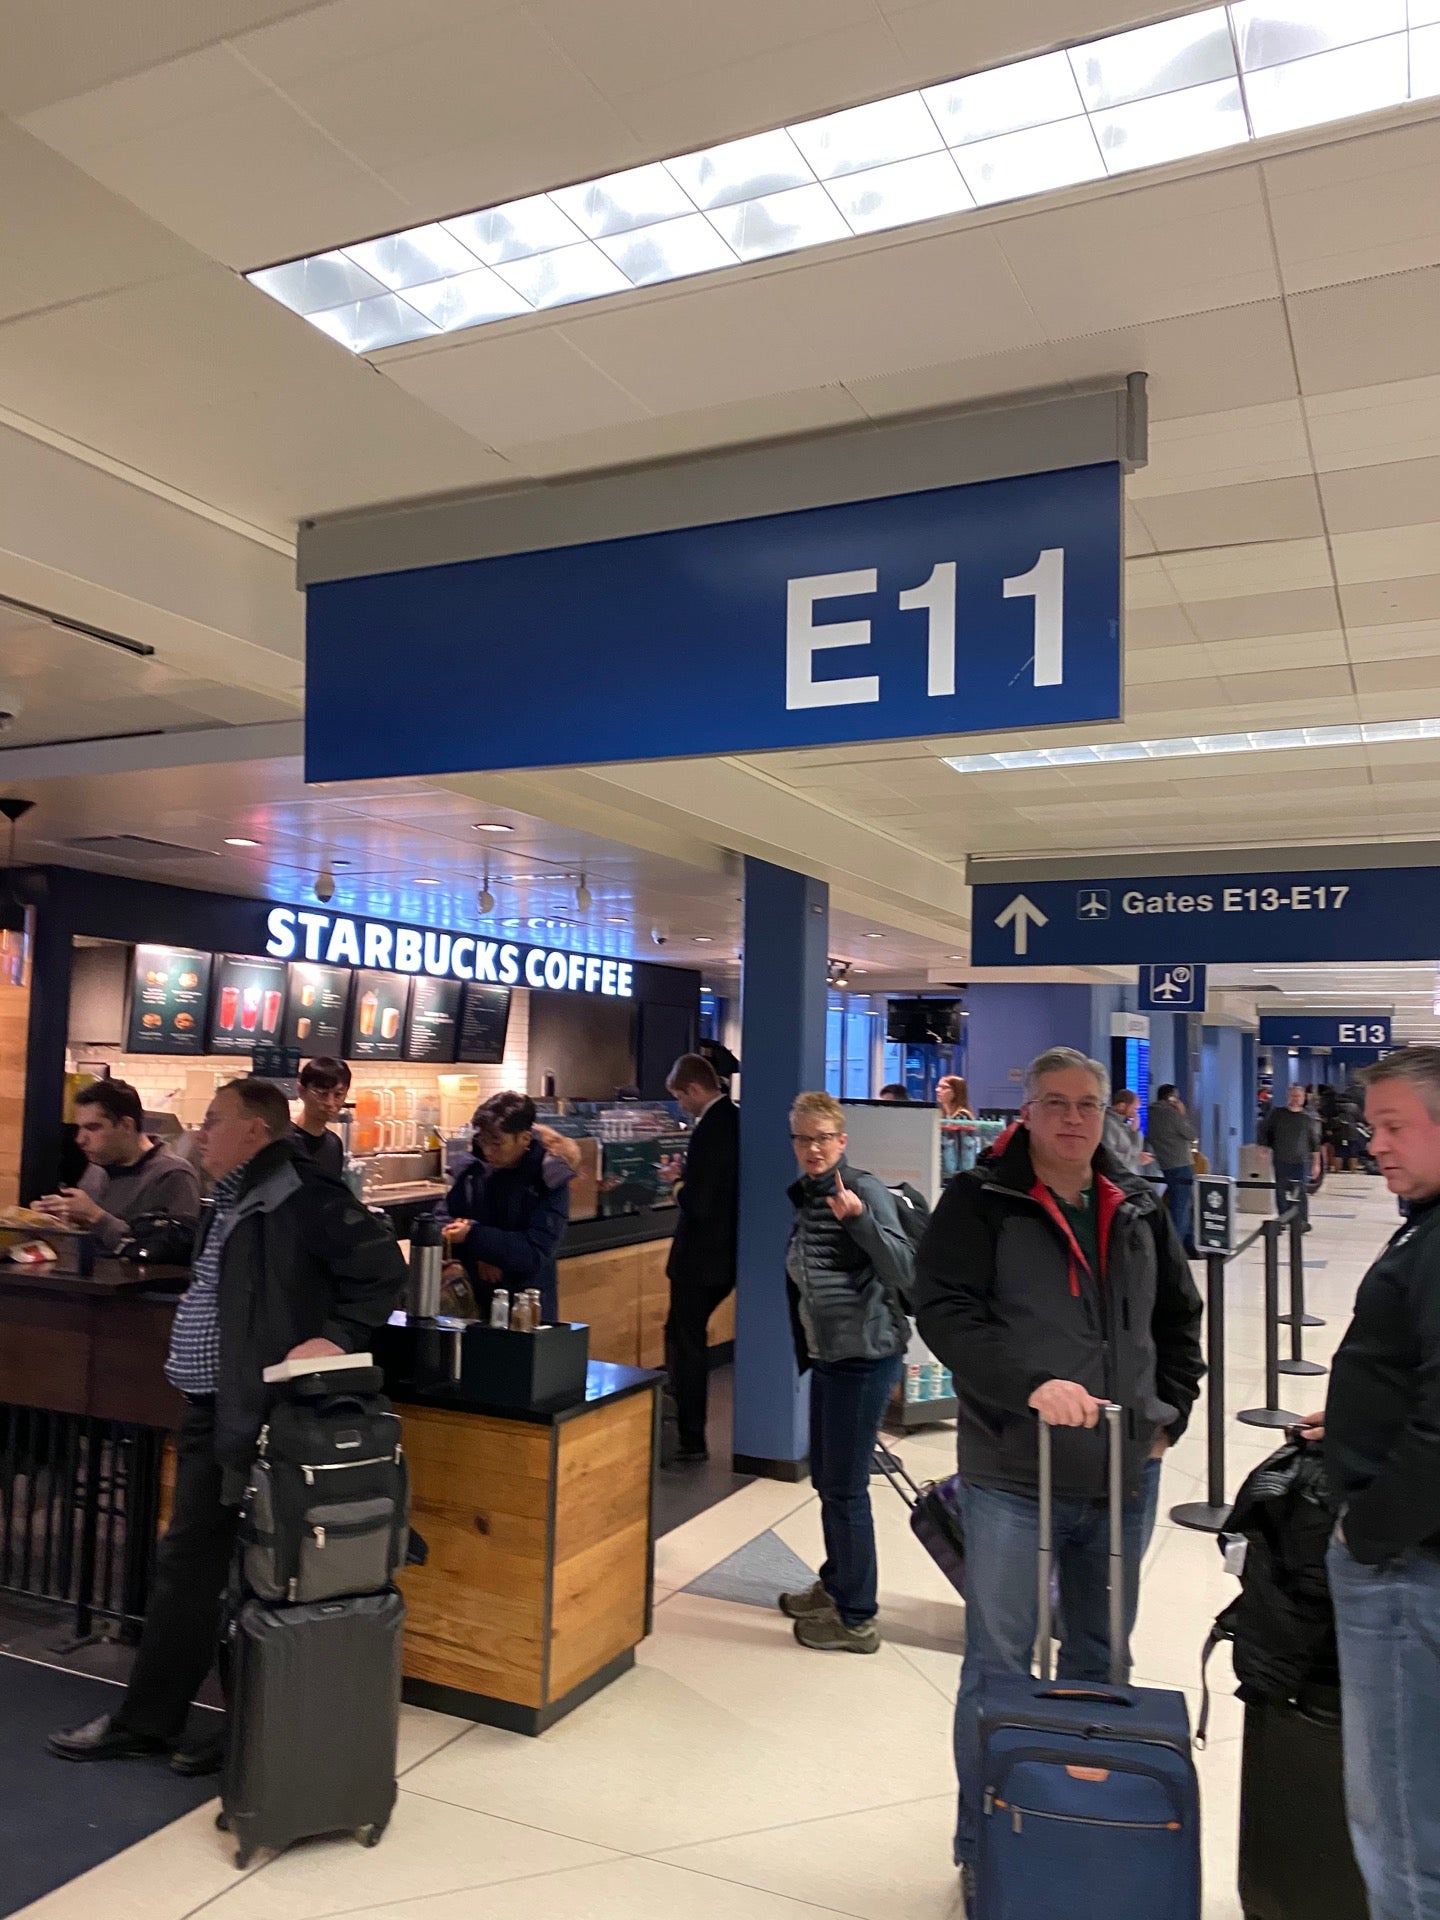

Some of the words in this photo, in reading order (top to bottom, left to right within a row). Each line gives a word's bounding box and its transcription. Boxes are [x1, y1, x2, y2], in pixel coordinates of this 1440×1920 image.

[785, 547, 1064, 711] E11
[1121, 890, 1214, 915] Gates
[1222, 886, 1350, 913] E13-E17
[265, 907, 519, 985] STARBUCKS
[525, 948, 634, 997] COFFEE
[1338, 1023, 1386, 1044] E13
